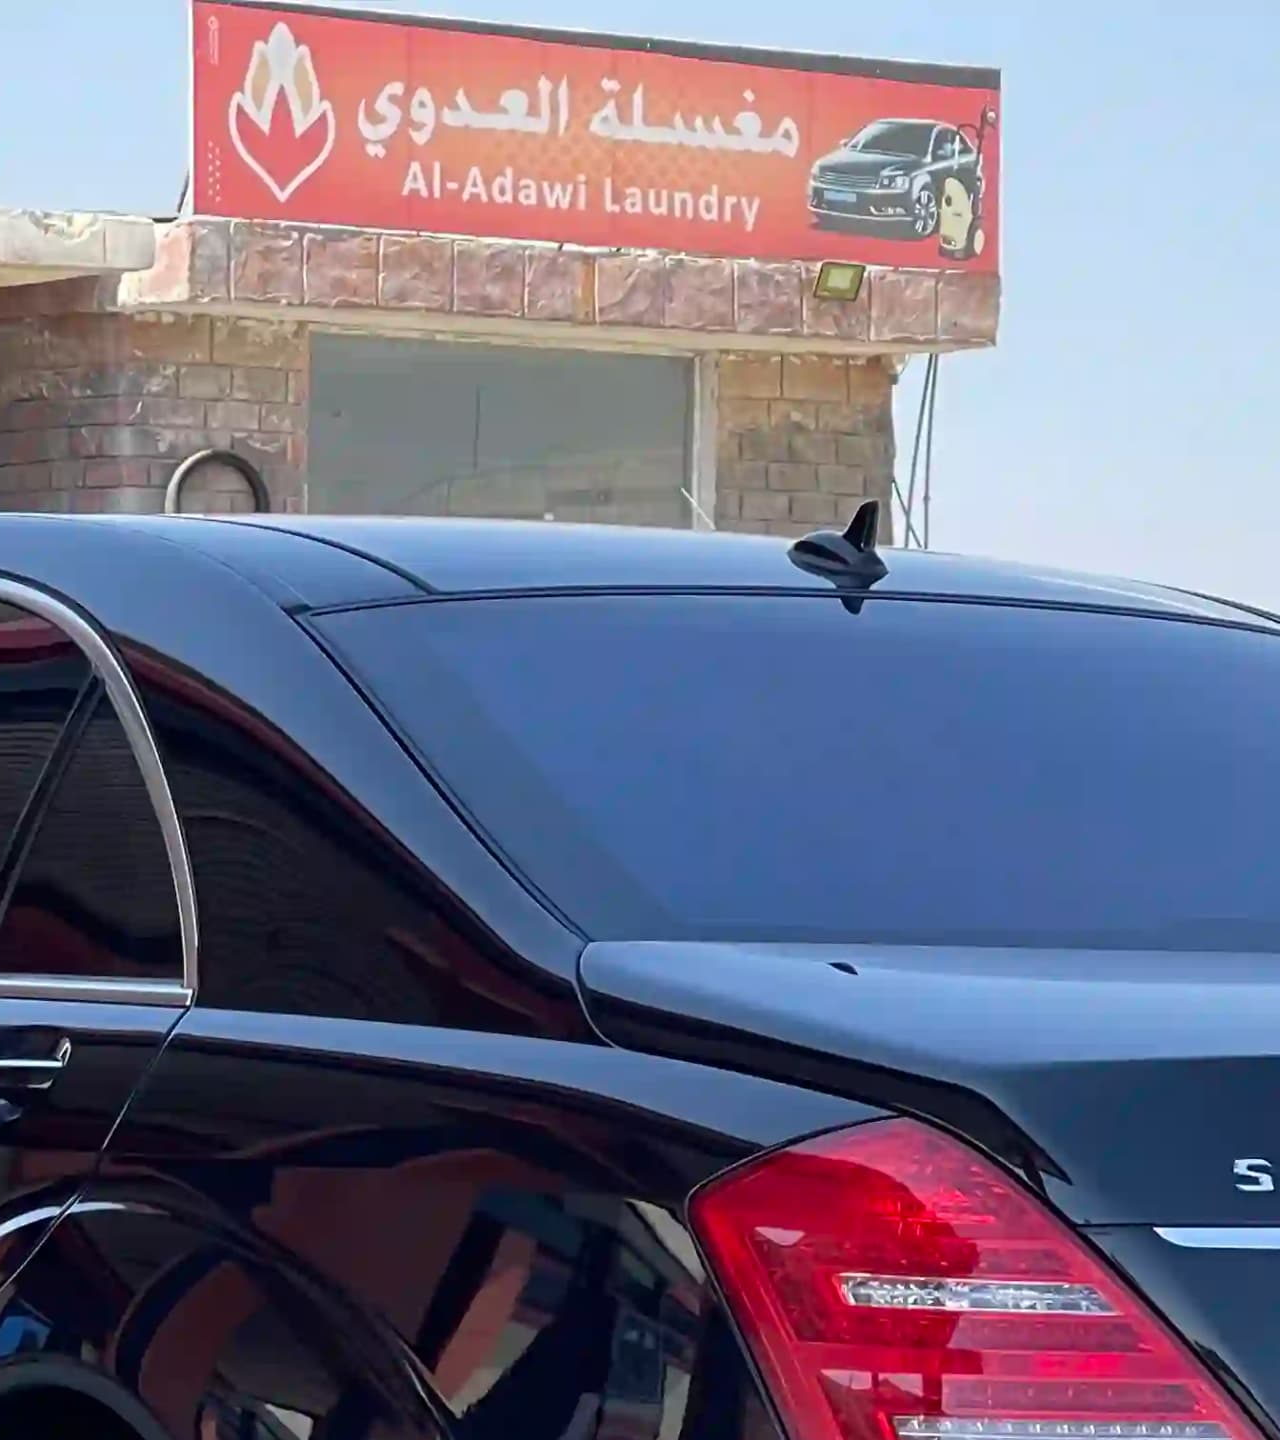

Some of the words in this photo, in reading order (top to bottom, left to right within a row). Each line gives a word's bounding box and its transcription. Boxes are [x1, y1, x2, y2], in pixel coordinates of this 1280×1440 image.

[356, 73, 569, 159] العدوي
[588, 76, 801, 159] مغسلة
[401, 160, 587, 210] Al-Adawi
[604, 176, 761, 232] Laundry
